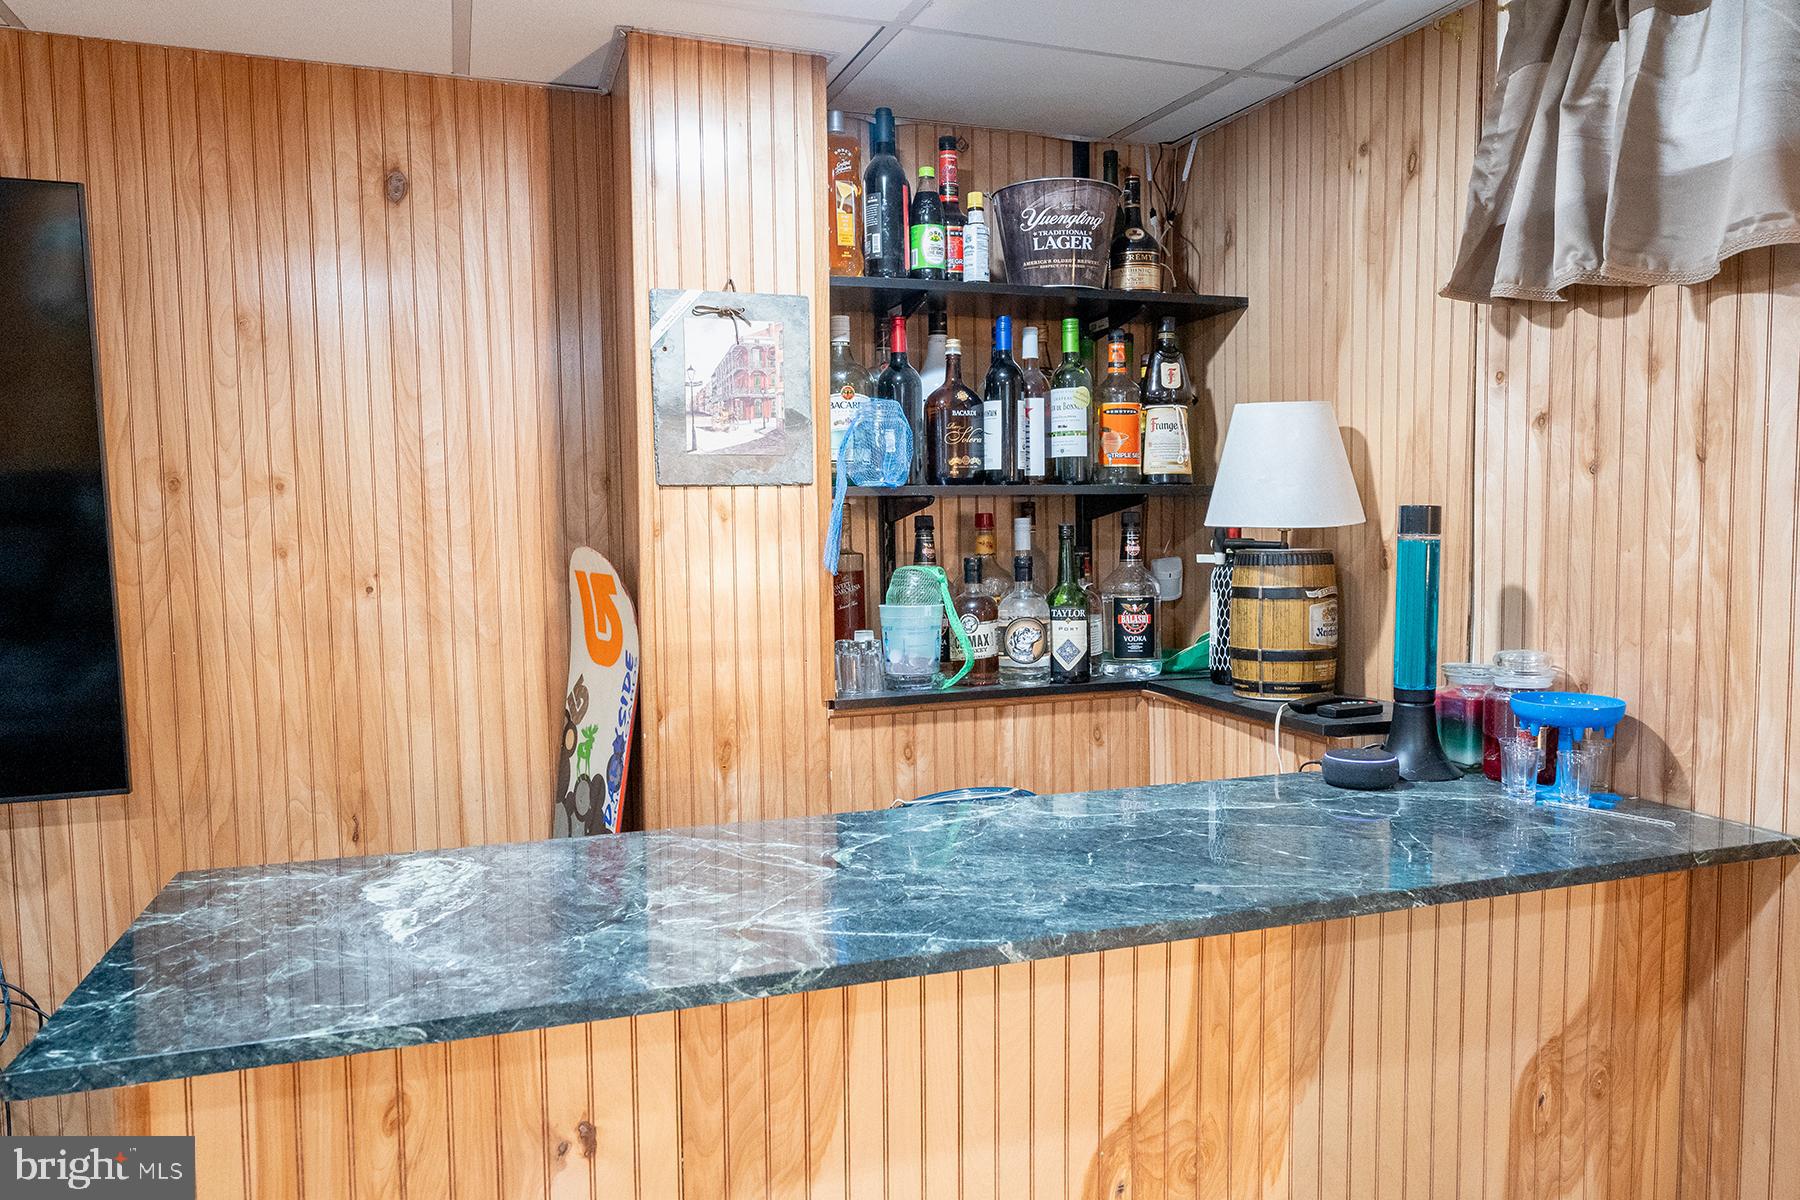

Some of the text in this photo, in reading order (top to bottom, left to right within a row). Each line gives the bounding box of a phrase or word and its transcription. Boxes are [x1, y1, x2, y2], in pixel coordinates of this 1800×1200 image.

[1020, 206, 1105, 231] Yuengling
[1033, 236, 1093, 251] LAGER
[1051, 608, 1086, 618] TAYLOR
